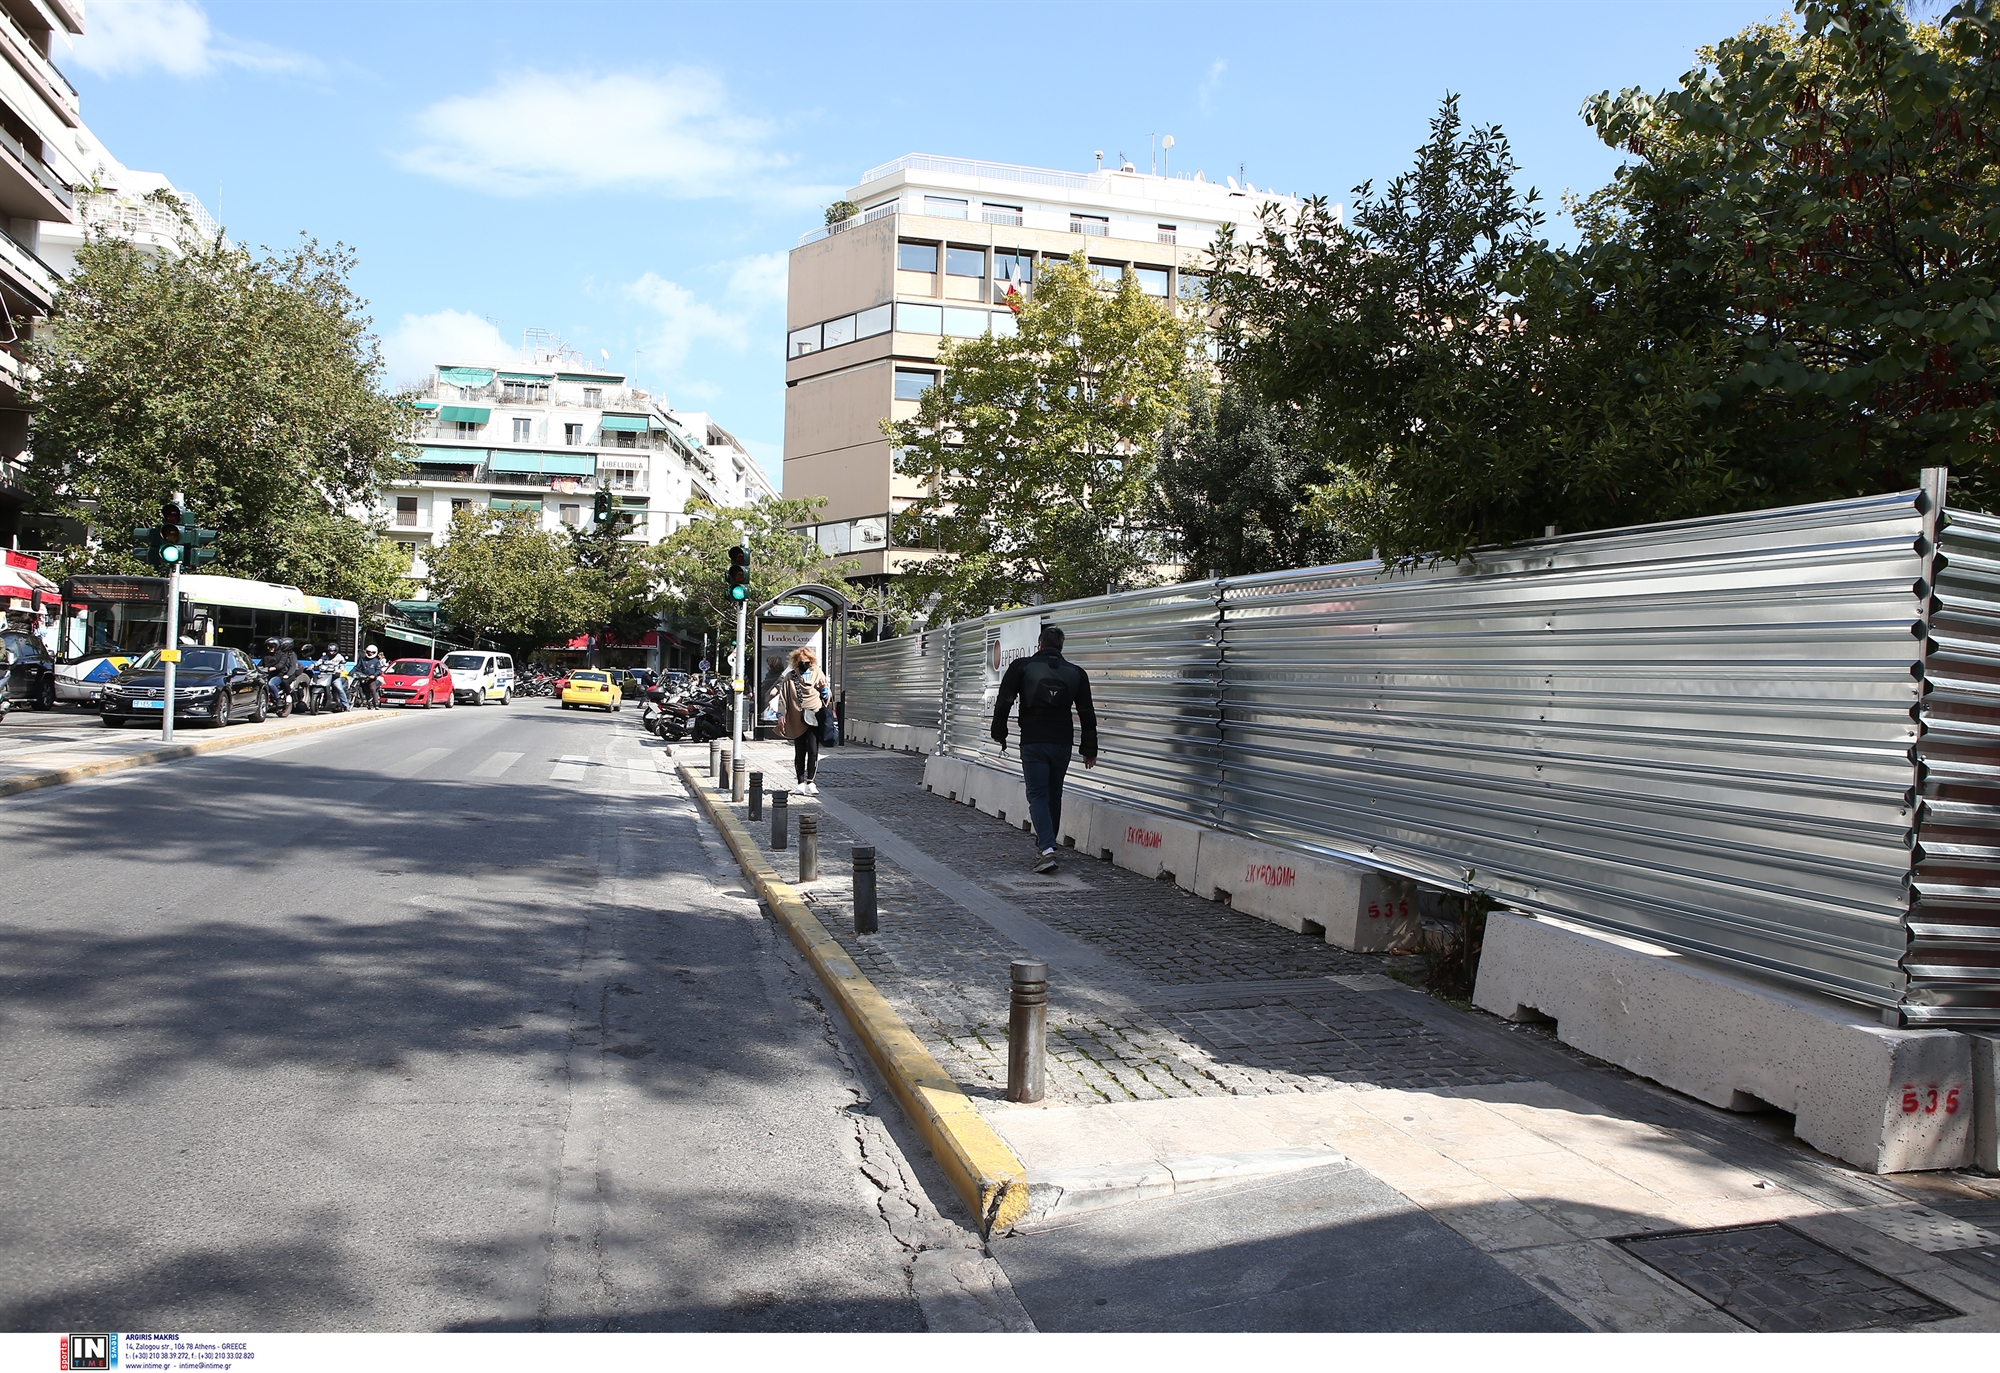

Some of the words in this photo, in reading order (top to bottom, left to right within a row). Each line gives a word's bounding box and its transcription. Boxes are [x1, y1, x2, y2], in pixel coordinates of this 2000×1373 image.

[602, 461, 643, 469] LIBELLOULA
[767, 634, 792, 642] Hondos
[1245, 864, 1296, 887] ΣΚΥΡΟΔΟΜΗ
[1368, 901, 1409, 919] 535
[1901, 1088, 1960, 1114] 535
